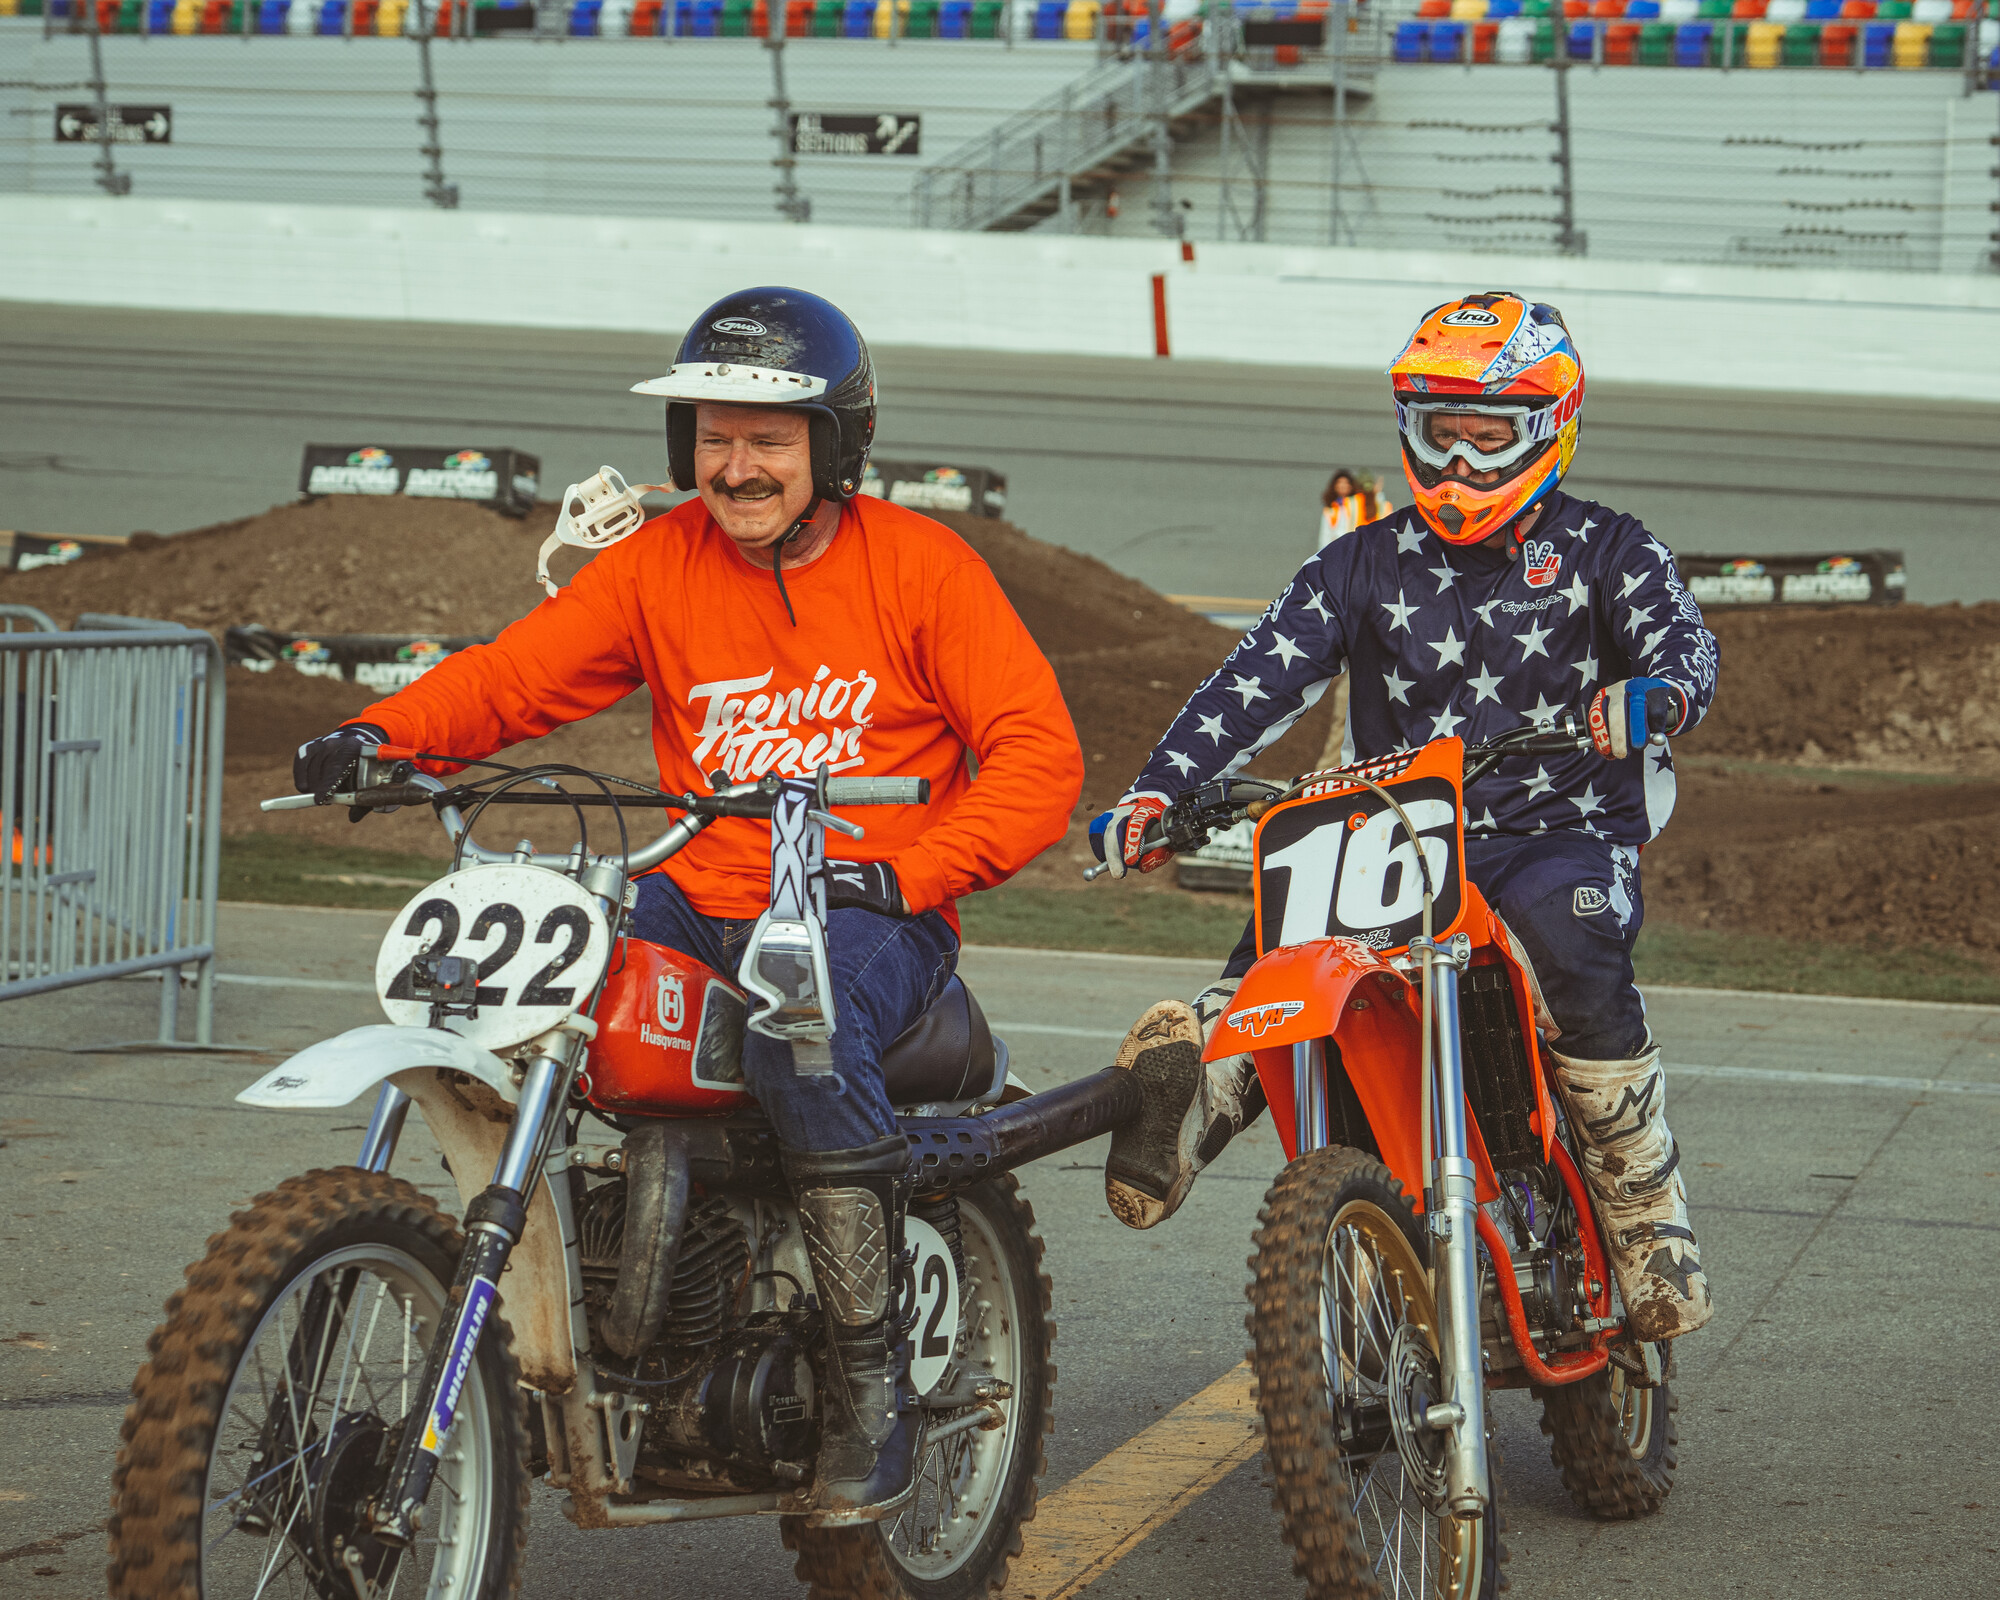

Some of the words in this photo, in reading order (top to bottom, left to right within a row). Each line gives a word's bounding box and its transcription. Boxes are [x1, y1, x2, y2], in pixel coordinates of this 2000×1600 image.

[796, 114, 822, 132] ALL
[796, 132, 867, 153] SECTIONS
[719, 320, 760, 334] GMAX
[355, 663, 437, 685] DAYTO
[1302, 757, 1417, 799] RENTH
[1123, 806, 1161, 862] HONDA
[1263, 799, 1455, 947] 16
[385, 898, 590, 1007] 222
[640, 1022, 693, 1052] Husqvarna
[1240, 1008, 1285, 1037] FVH
[445, 1295, 489, 1413] MICHELIN
